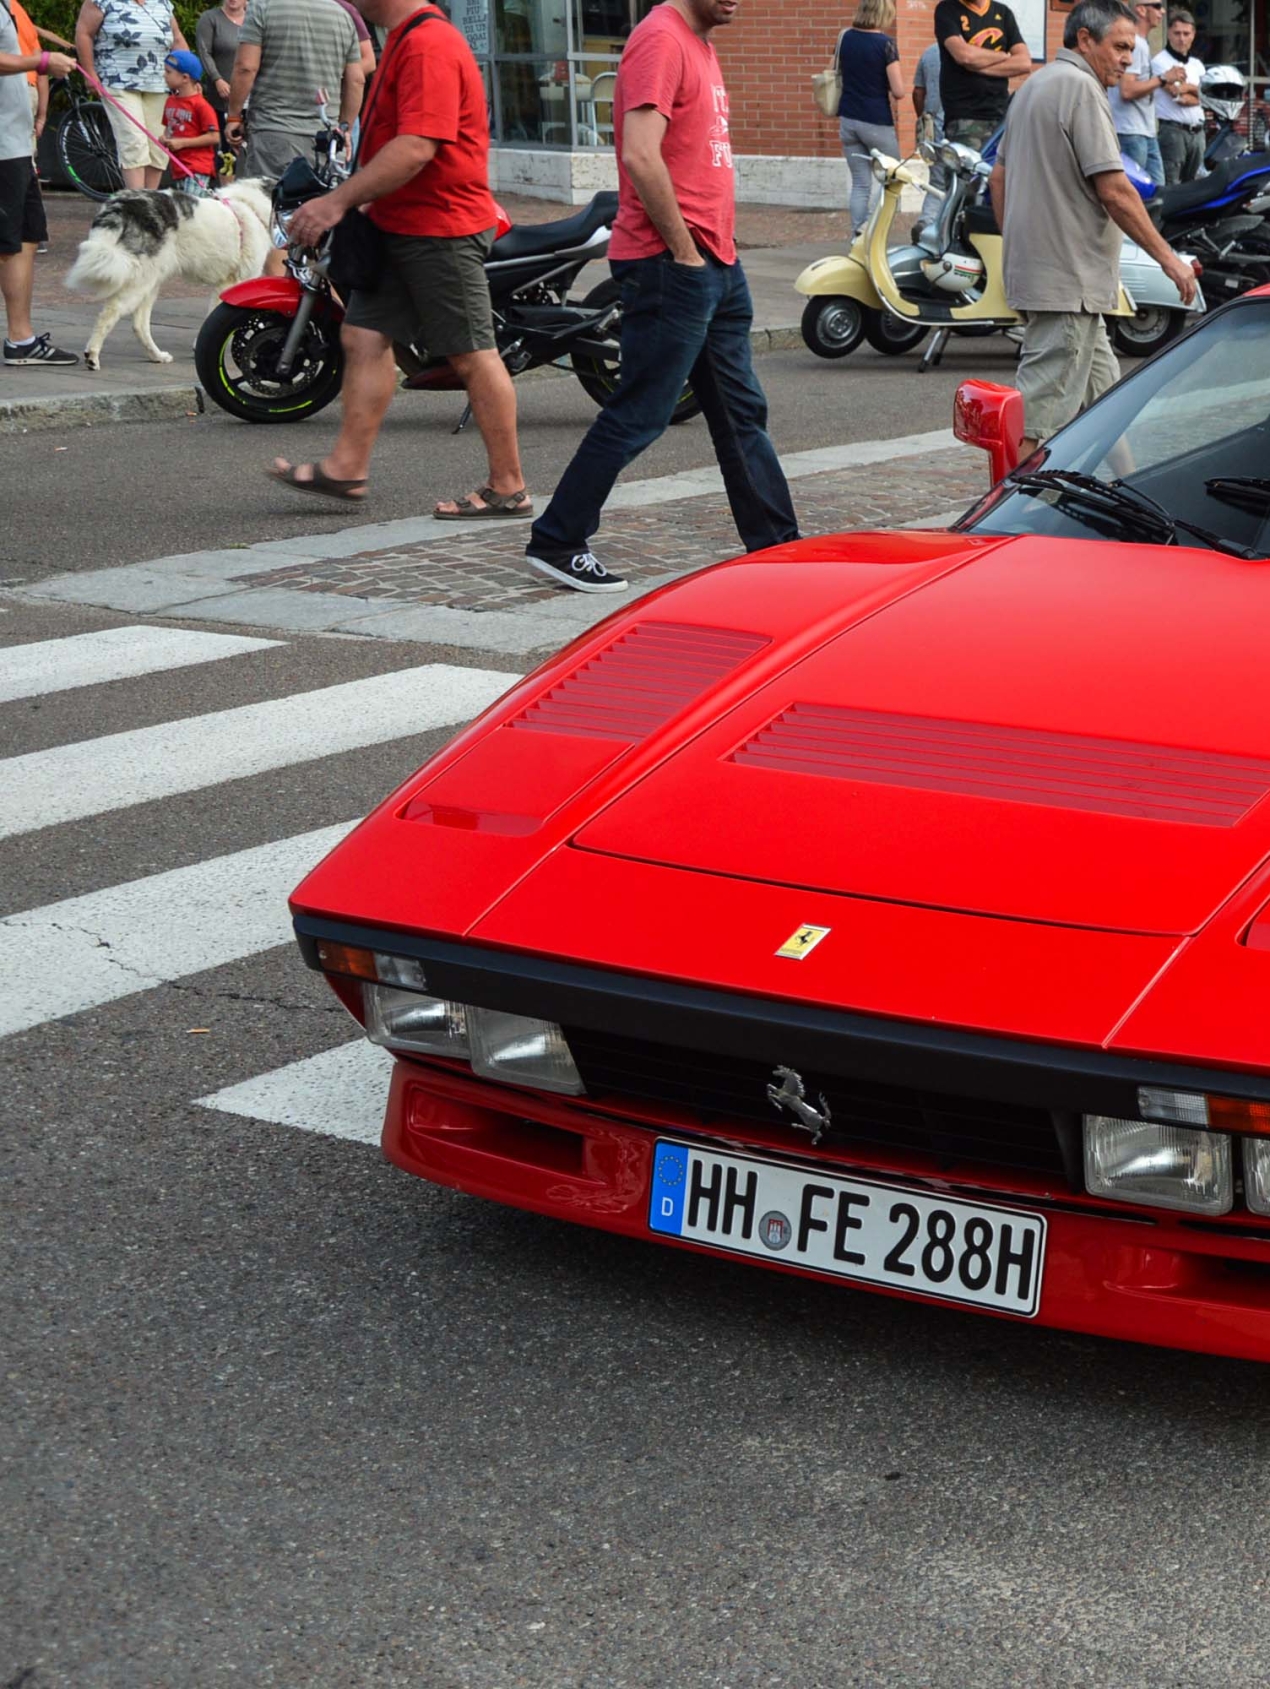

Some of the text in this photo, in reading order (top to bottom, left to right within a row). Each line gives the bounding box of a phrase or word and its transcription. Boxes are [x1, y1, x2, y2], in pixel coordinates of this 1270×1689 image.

[960, 14, 970, 31] 2
[660, 1196, 674, 1217] D
[686, 1159, 1036, 1301] HH FE 288H
